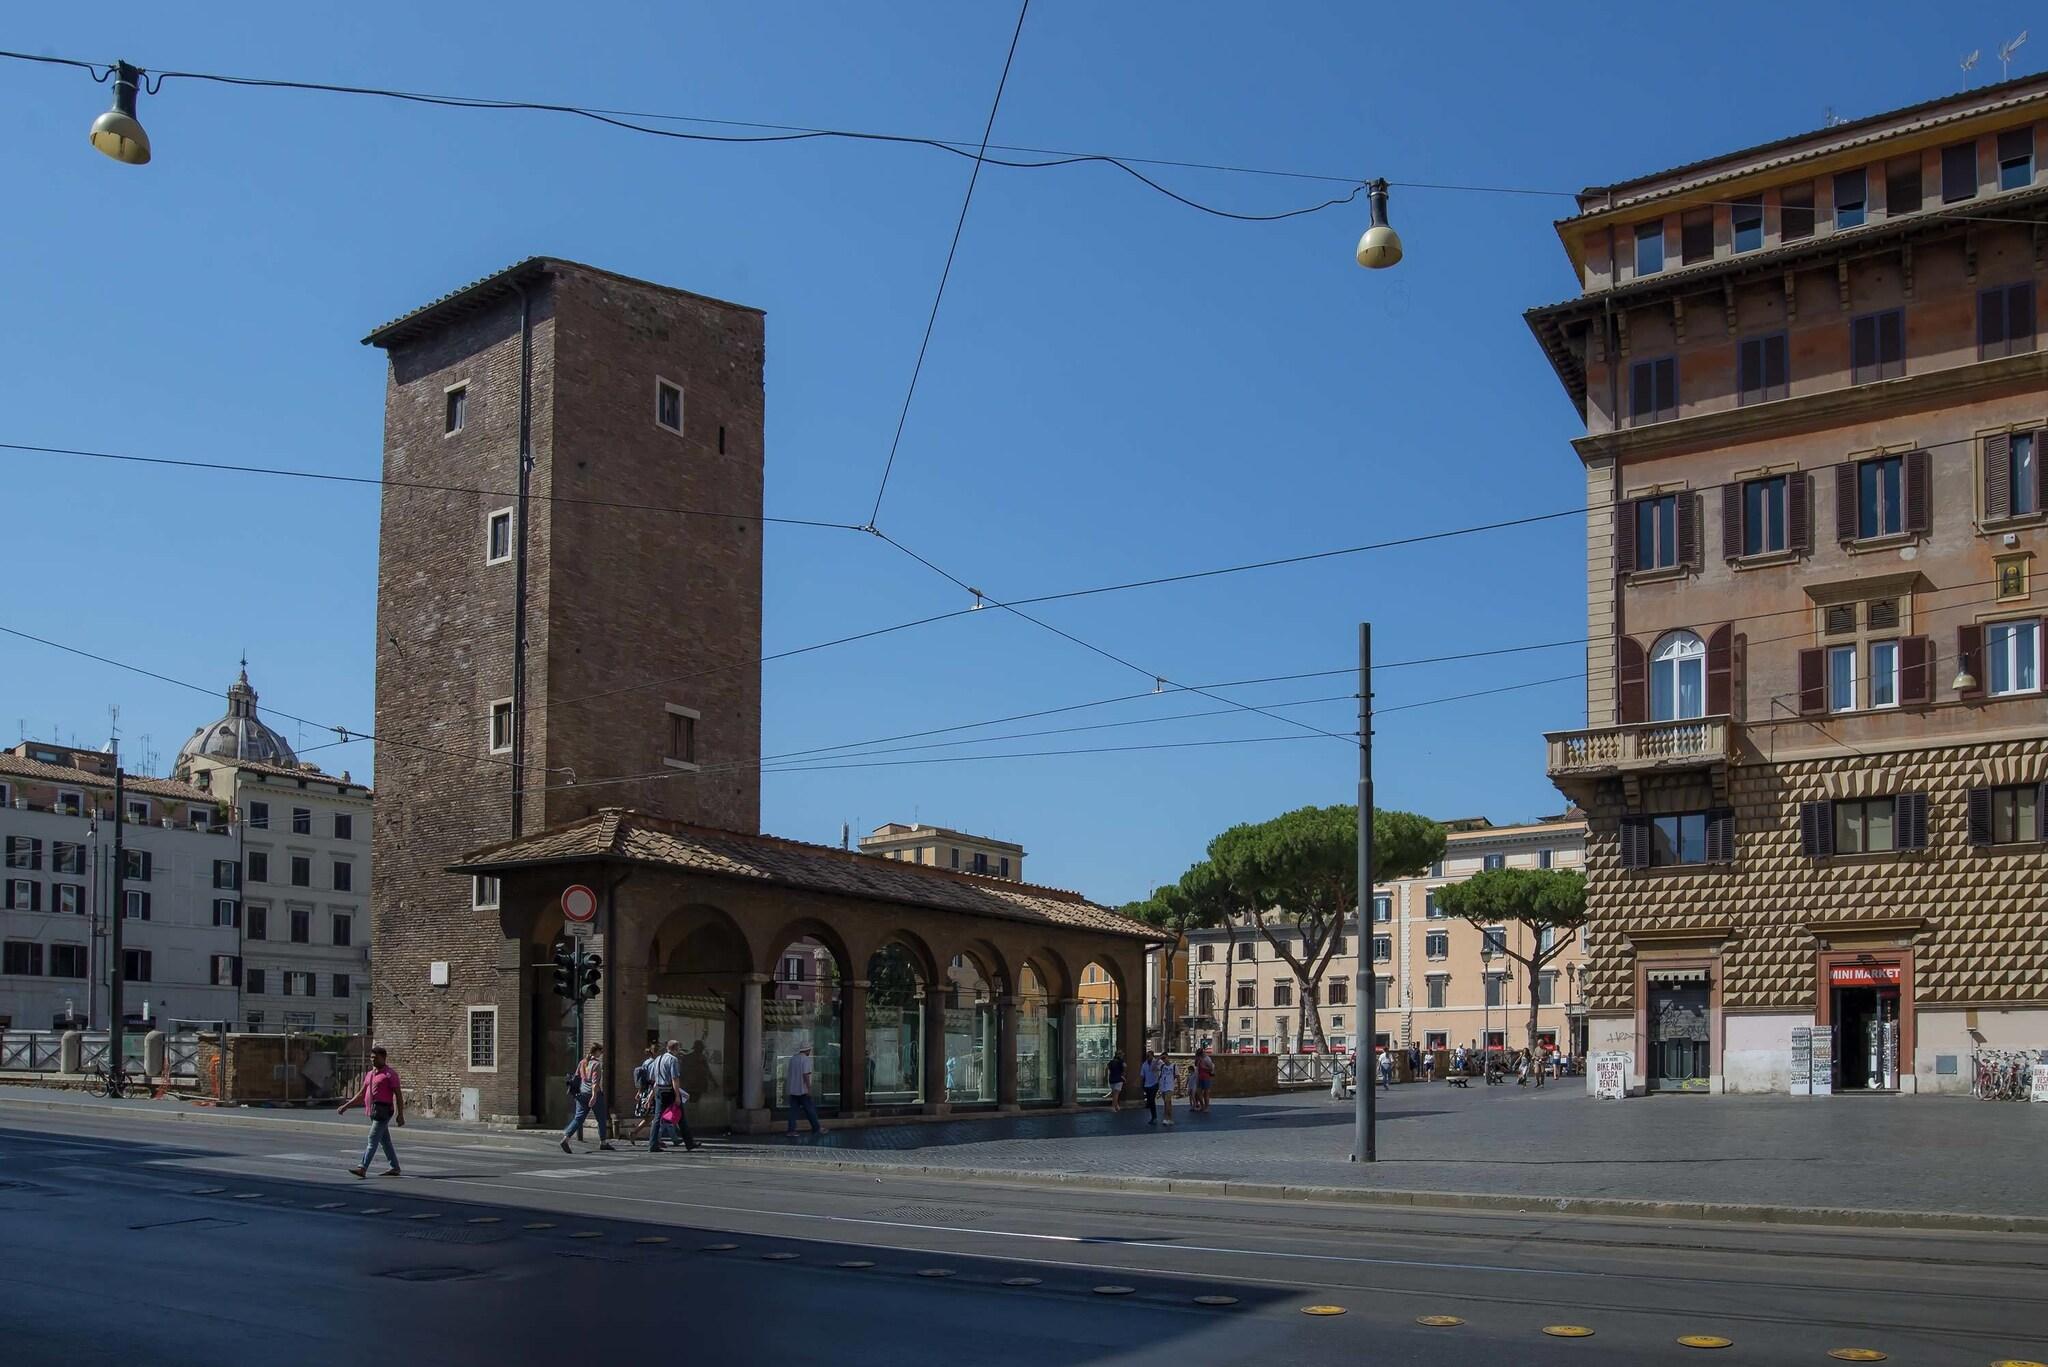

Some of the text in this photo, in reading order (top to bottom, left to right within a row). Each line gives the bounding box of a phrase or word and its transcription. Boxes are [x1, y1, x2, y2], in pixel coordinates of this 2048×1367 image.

[1830, 968, 1900, 979] MINI MARKET
[1597, 1062, 1622, 1071] BIKE AND
[1601, 1071, 1618, 1079] VESPA
